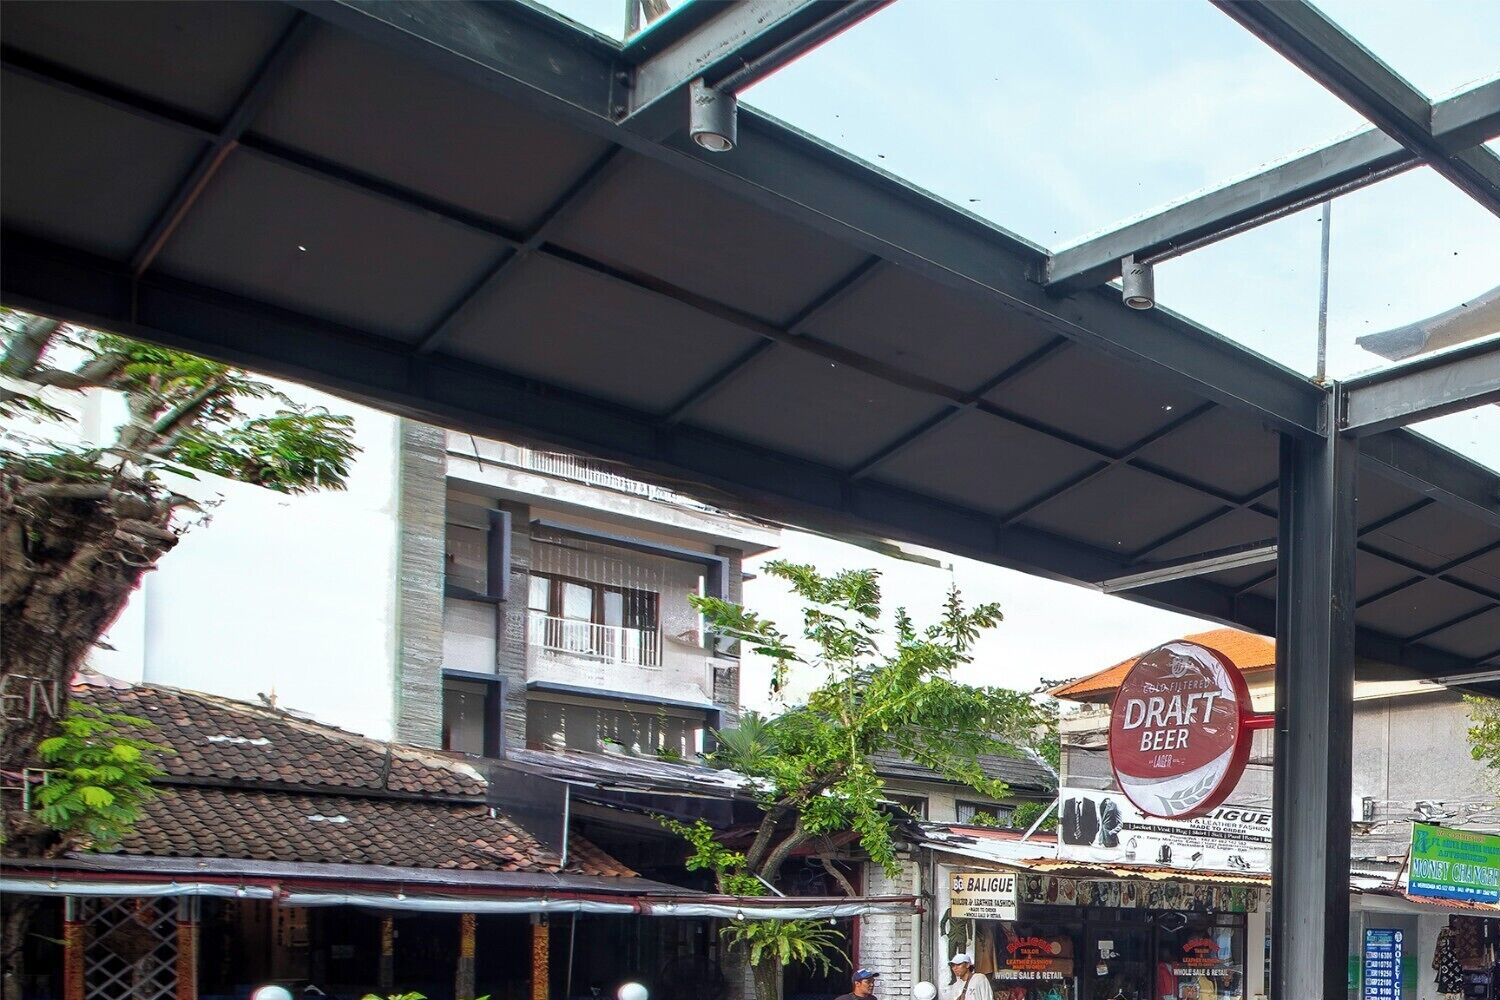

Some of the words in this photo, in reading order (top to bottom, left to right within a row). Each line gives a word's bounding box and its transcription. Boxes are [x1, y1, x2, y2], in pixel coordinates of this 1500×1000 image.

[1123, 689, 1222, 730] DRAFT
[1140, 729, 1190, 752] BEER
[1199, 809, 1272, 825] IGUE
[1202, 818, 1238, 828] LEATHER
[1239, 824, 1271, 832] FASHION
[1412, 857, 1450, 881] MONEY
[1452, 862, 1500, 887] CHANGER
[967, 877, 1014, 893] BALIGUE
[995, 972, 1018, 980] WHOLE
[1019, 972, 1035, 980] SALE
[1035, 971, 1041, 980] &
[1042, 971, 1063, 980] RETAIL
